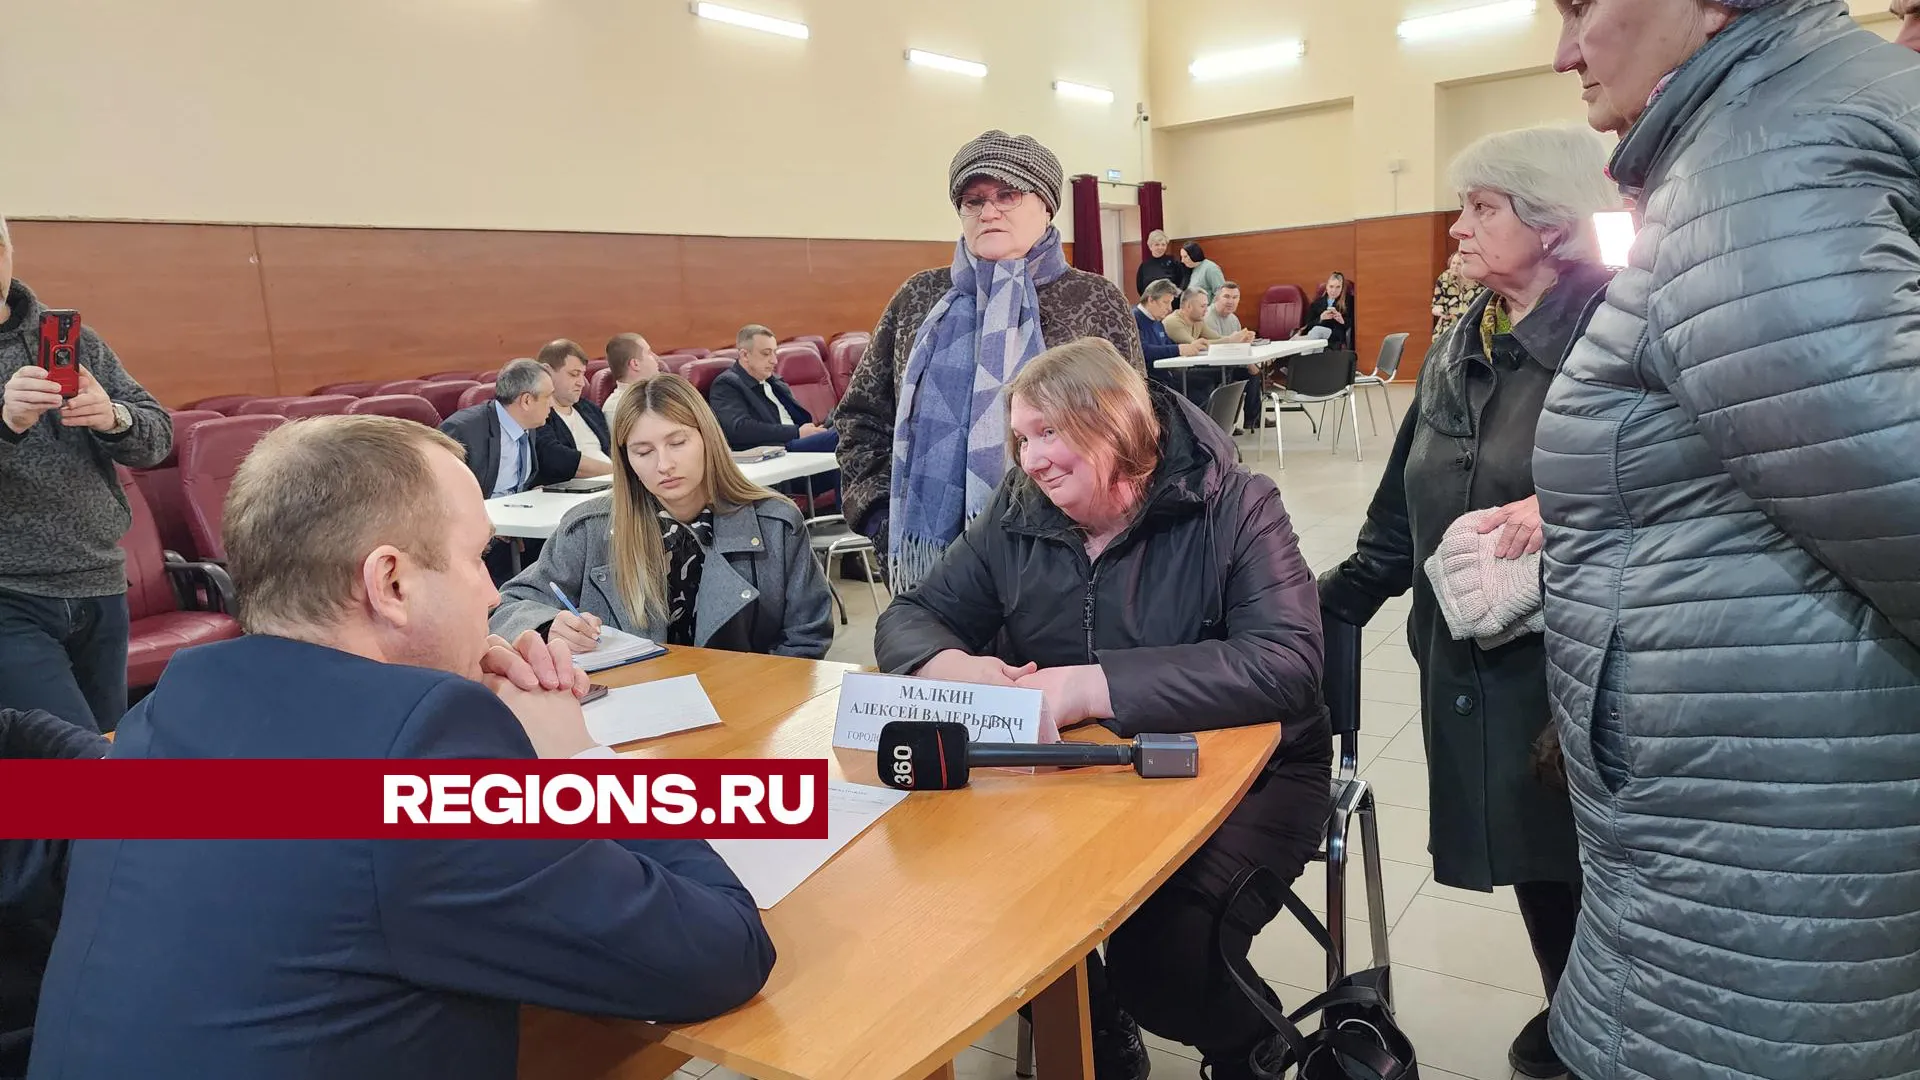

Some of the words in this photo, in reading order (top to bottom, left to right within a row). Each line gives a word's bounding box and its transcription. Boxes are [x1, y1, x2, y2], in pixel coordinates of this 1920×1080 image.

[900, 685, 975, 705] МАЛКИН
[850, 702, 918, 720] АЛЕКСЕЙ
[922, 709, 1024, 731] ВАЛЕРЬЕВИЧ
[893, 745, 913, 785] 360
